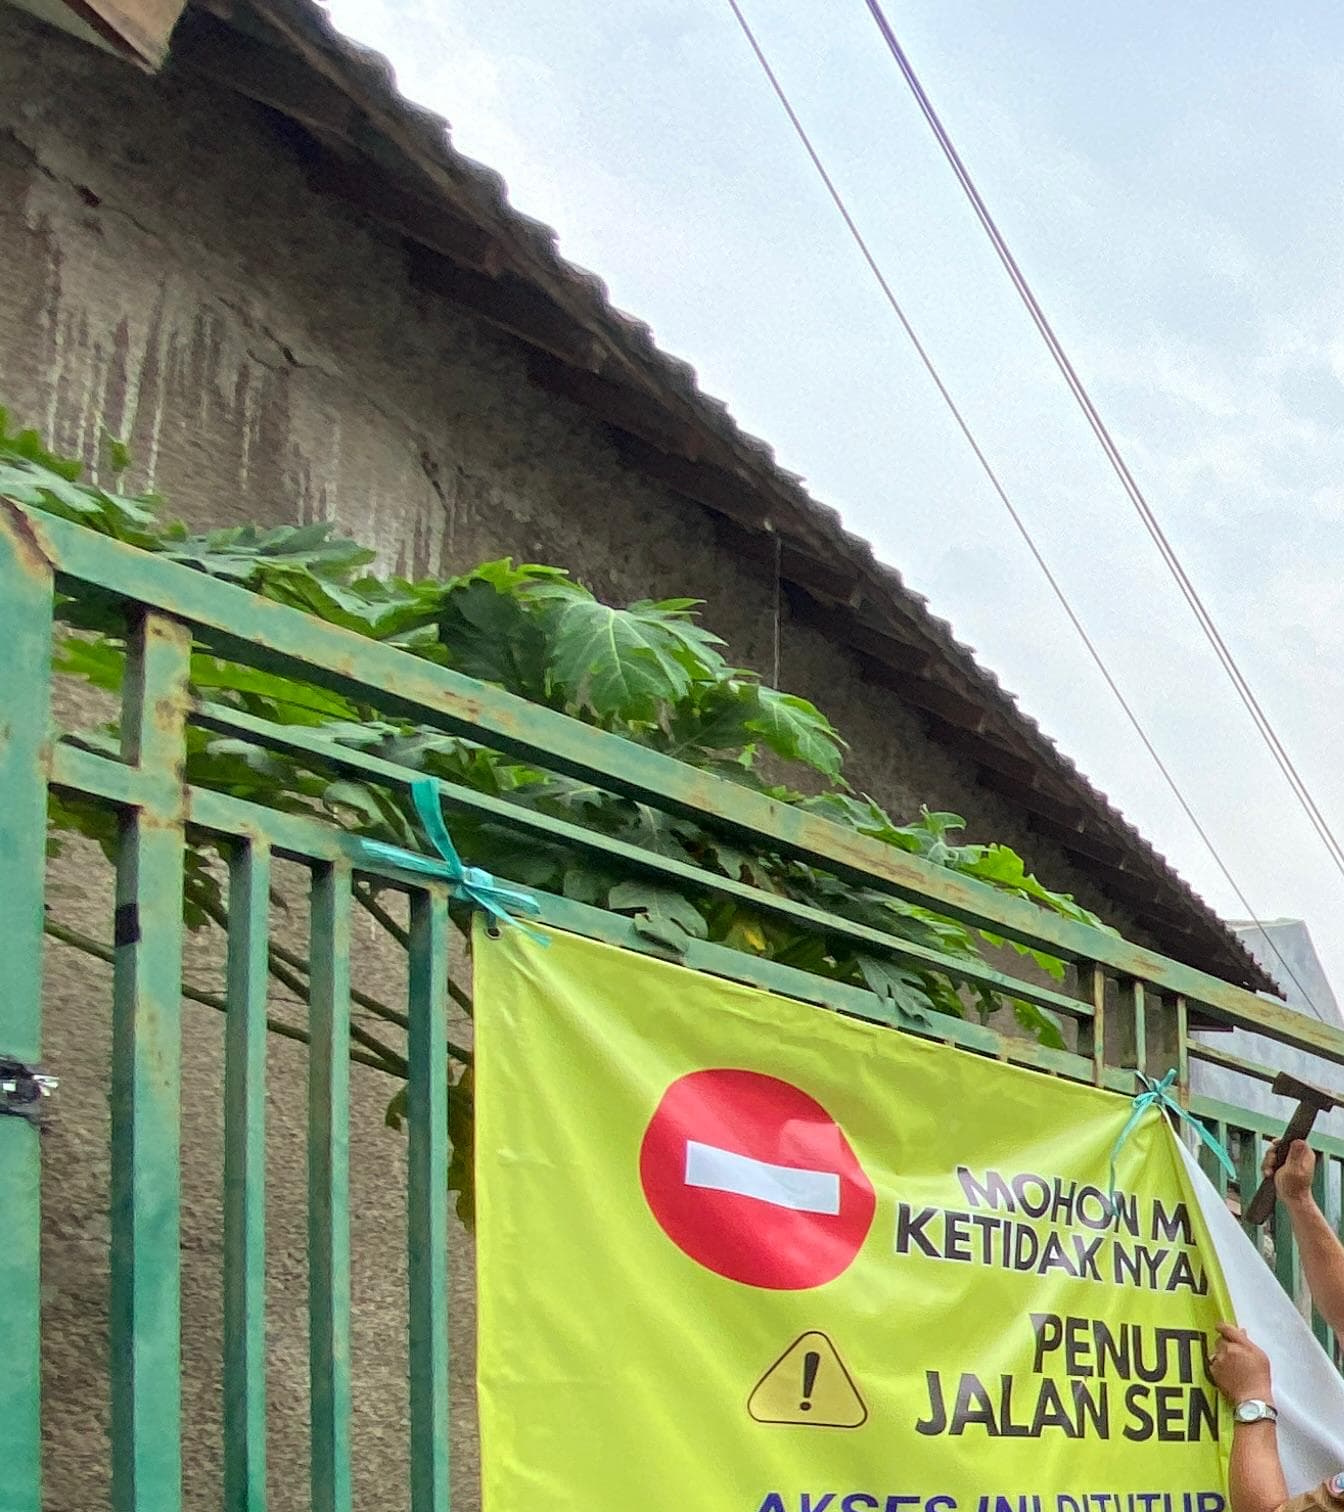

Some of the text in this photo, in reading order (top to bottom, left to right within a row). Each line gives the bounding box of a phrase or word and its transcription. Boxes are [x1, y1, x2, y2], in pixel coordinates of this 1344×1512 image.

[896, 1203, 1104, 1281] KETIDAK
[957, 1166, 1197, 1246] MOHON M
[915, 1371, 1110, 1439] JALAN
